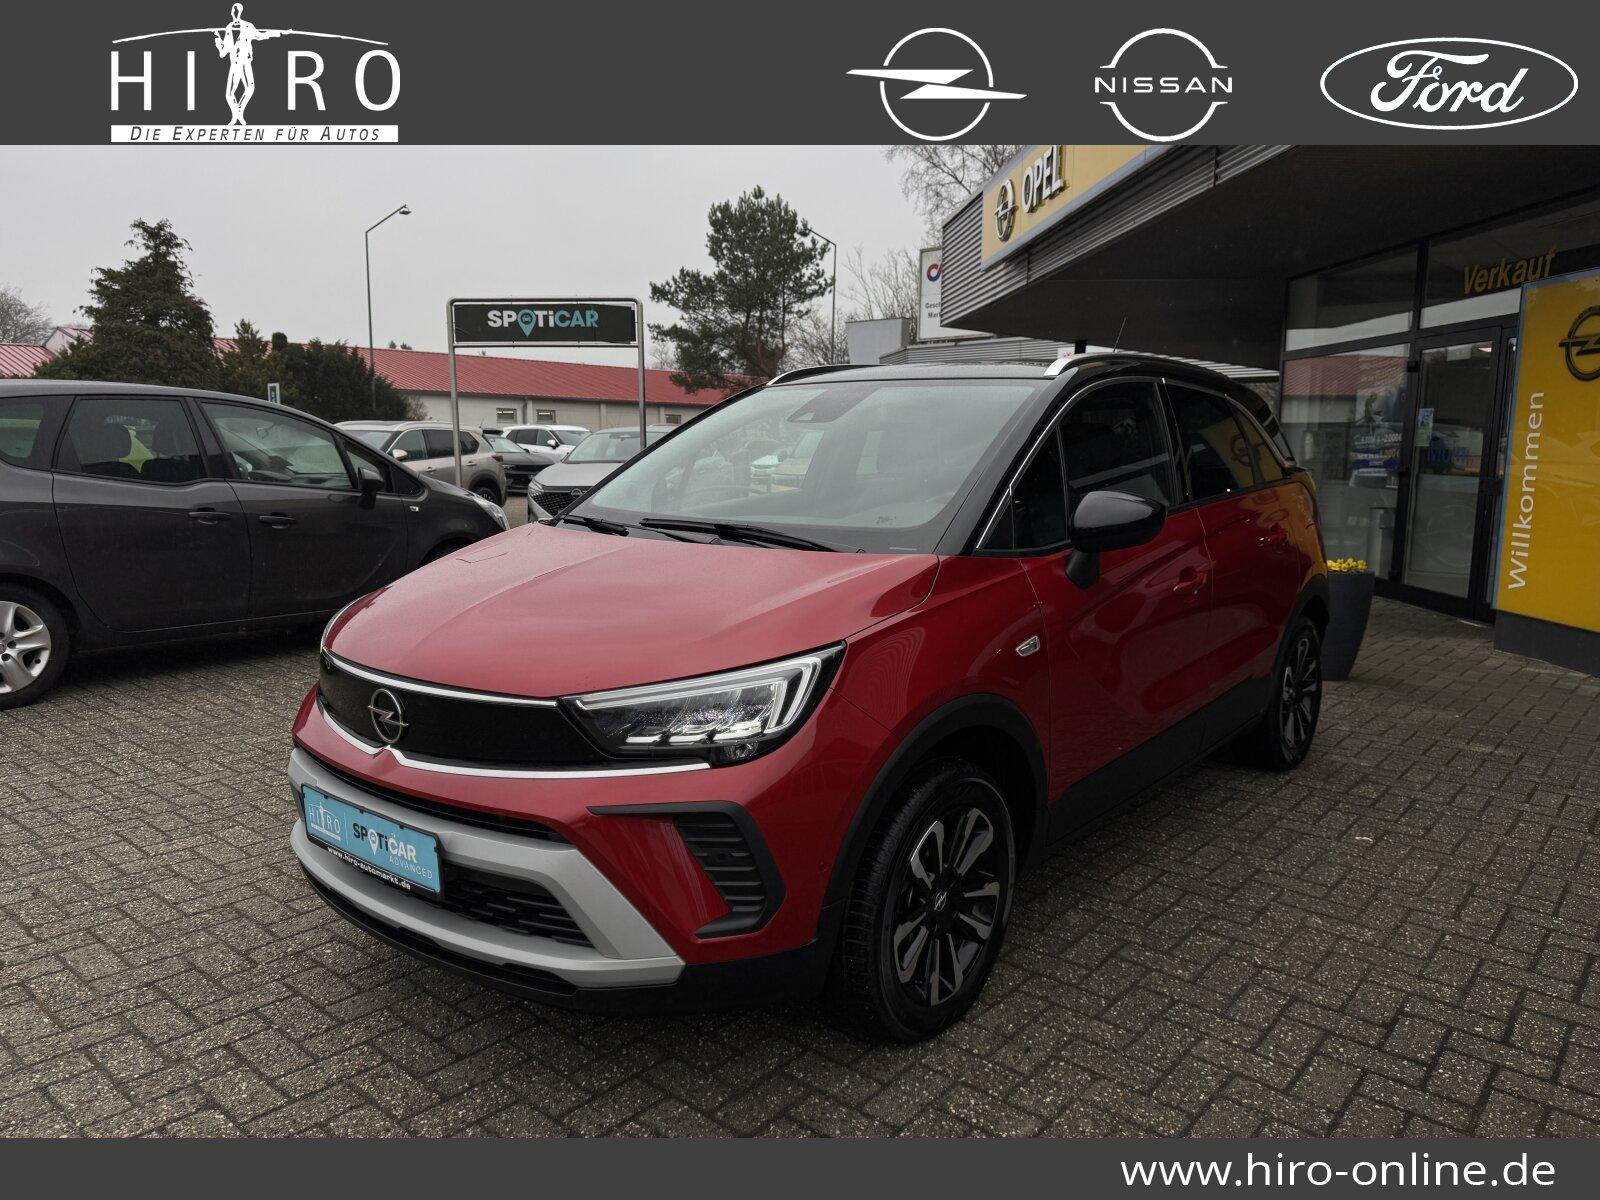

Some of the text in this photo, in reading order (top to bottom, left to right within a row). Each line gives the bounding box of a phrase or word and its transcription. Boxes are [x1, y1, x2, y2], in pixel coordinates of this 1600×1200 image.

[1021, 145, 1064, 213] OPEL
[1463, 245, 1557, 295] Verkauf
[1508, 391, 1545, 590] Willkommen
[308, 806, 341, 834] HIRO
[327, 847, 411, 891] www.hiro-automarkt.de
[389, 855, 433, 879] ADVANCED
